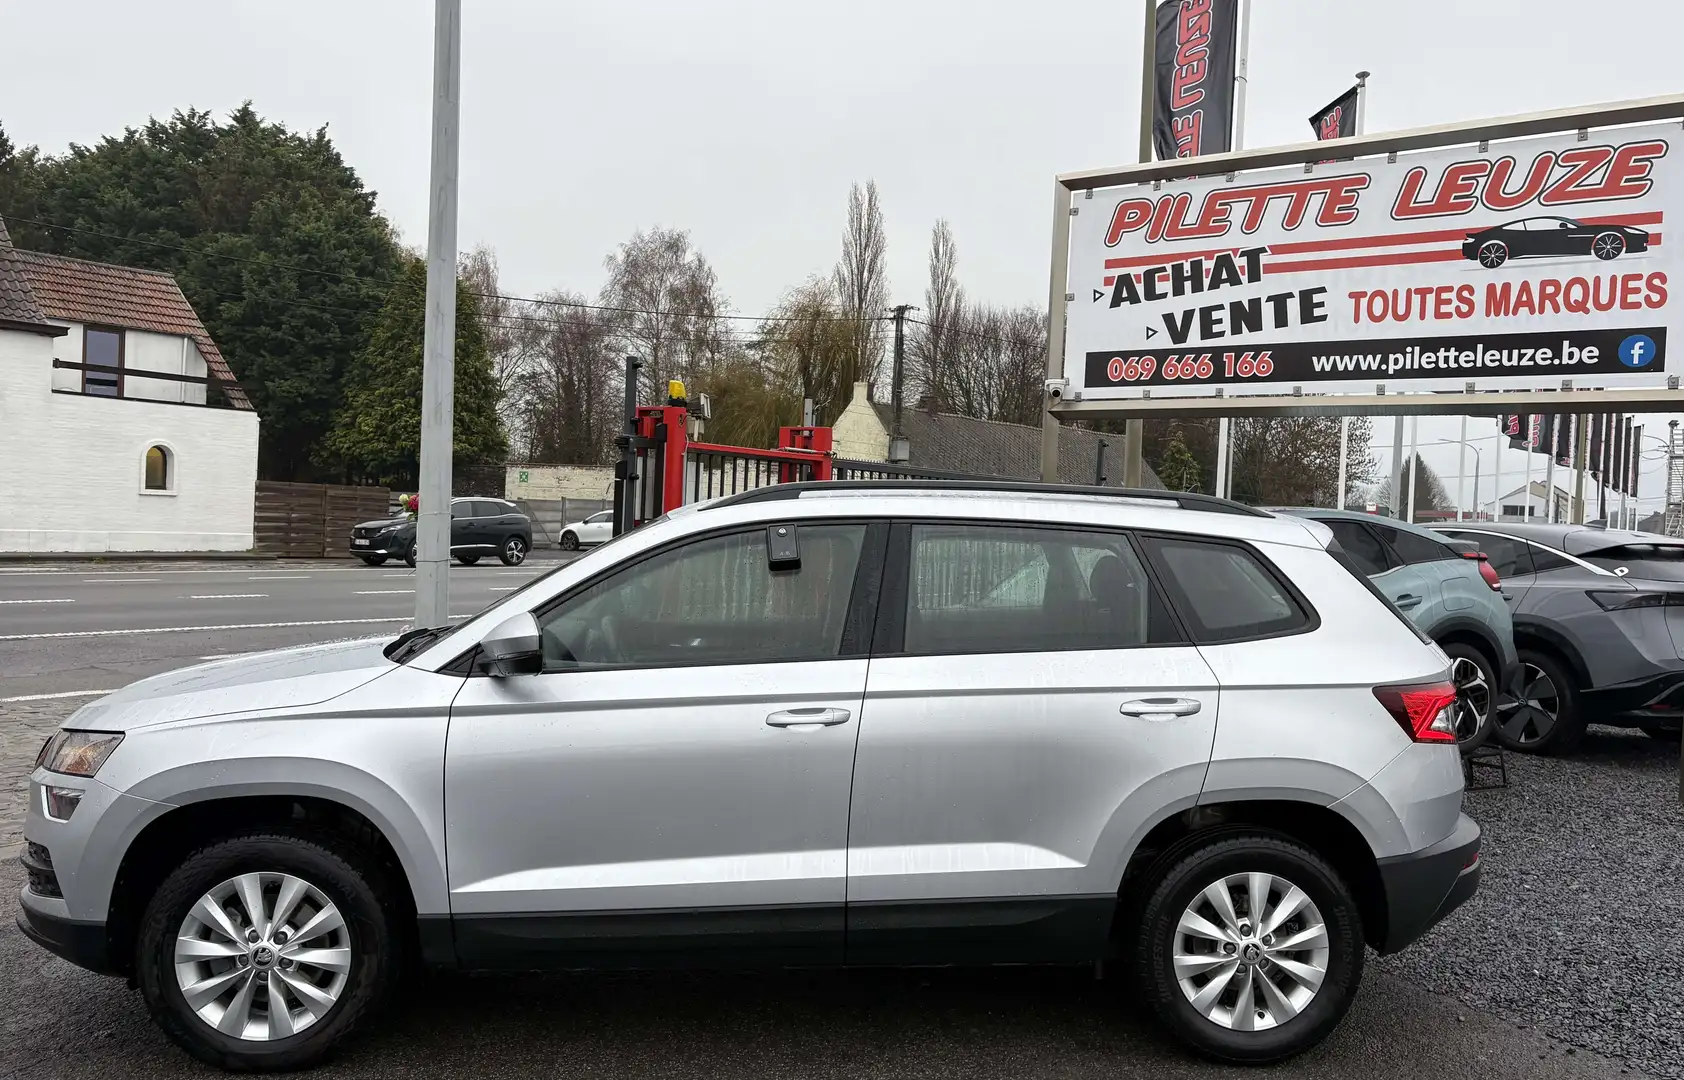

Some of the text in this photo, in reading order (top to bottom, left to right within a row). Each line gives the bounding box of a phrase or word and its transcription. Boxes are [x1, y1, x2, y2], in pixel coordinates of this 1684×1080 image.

[1104, 139, 1669, 247] PILETTE LEUZE
[1109, 246, 1268, 309] ACHAT
[1348, 271, 1668, 324] TOUTES MARQUES
[1162, 286, 1329, 345] VENTE
[1107, 351, 1274, 381] 069 666 166
[1312, 340, 1599, 374] www.piletteleuze.be
